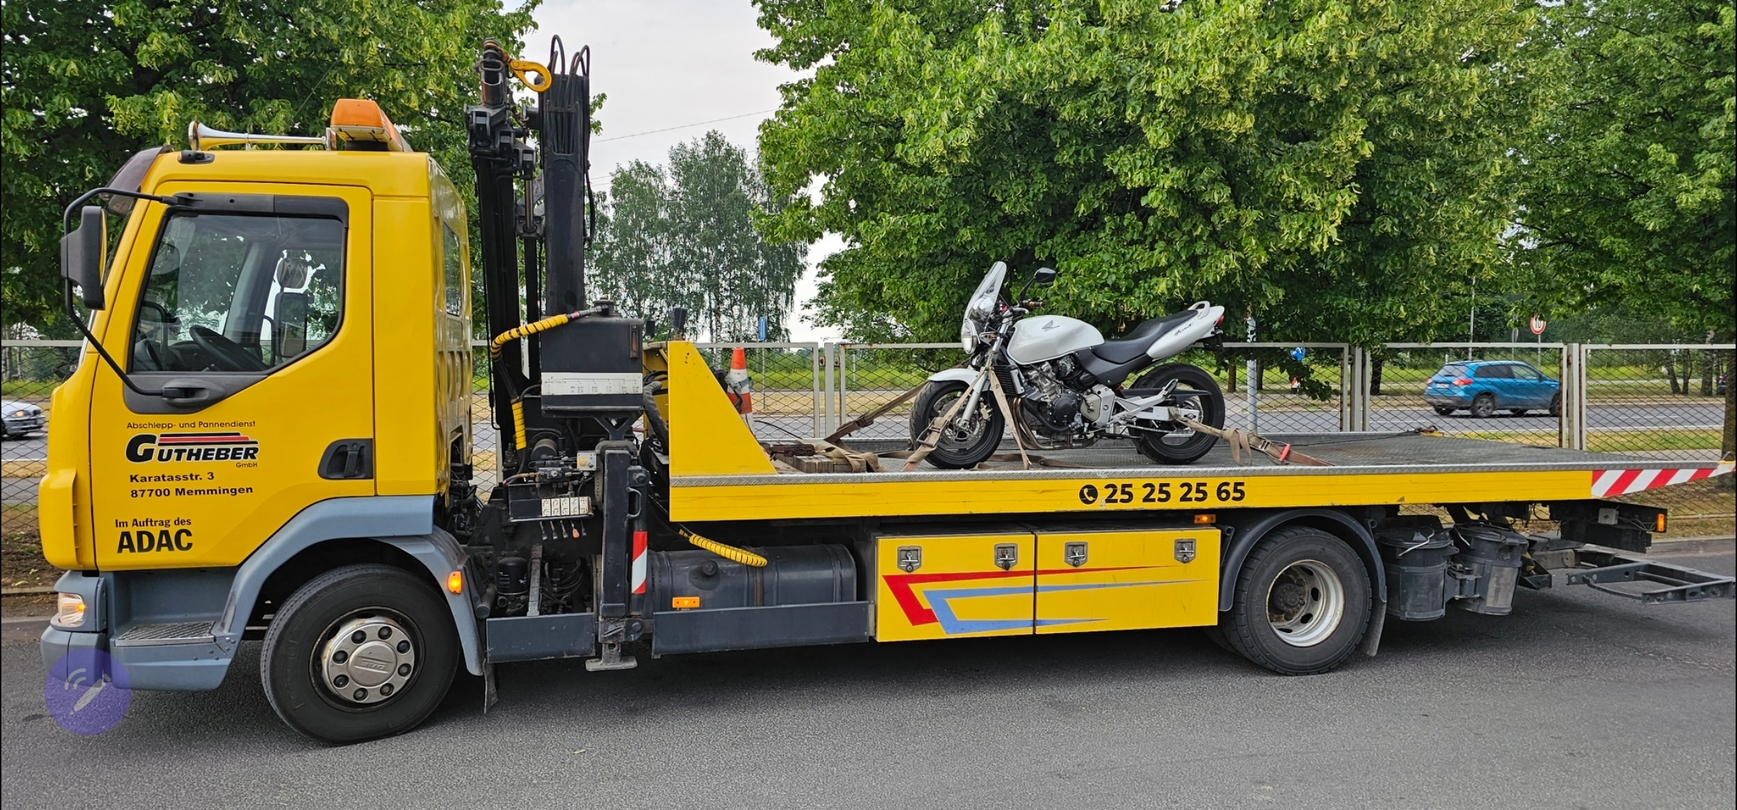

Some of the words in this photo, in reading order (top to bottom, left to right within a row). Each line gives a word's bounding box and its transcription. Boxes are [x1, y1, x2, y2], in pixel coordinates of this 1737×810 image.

[126, 422, 177, 430] Abschlepp-
[198, 420, 256, 428] Pannendienst
[126, 434, 260, 463] GUTHEBER
[129, 472, 203, 483] Karatasstr.
[207, 472, 215, 481] 3
[130, 488, 171, 498] 87700
[175, 486, 254, 496] Memmingen
[1103, 483, 1134, 504] 25
[1141, 482, 1172, 503] 25
[1179, 482, 1208, 502] 25
[1216, 481, 1246, 502] 65
[115, 518, 128, 528] Im
[131, 518, 171, 528] Auftrag
[174, 517, 192, 526] des
[116, 528, 194, 554] ADAC
